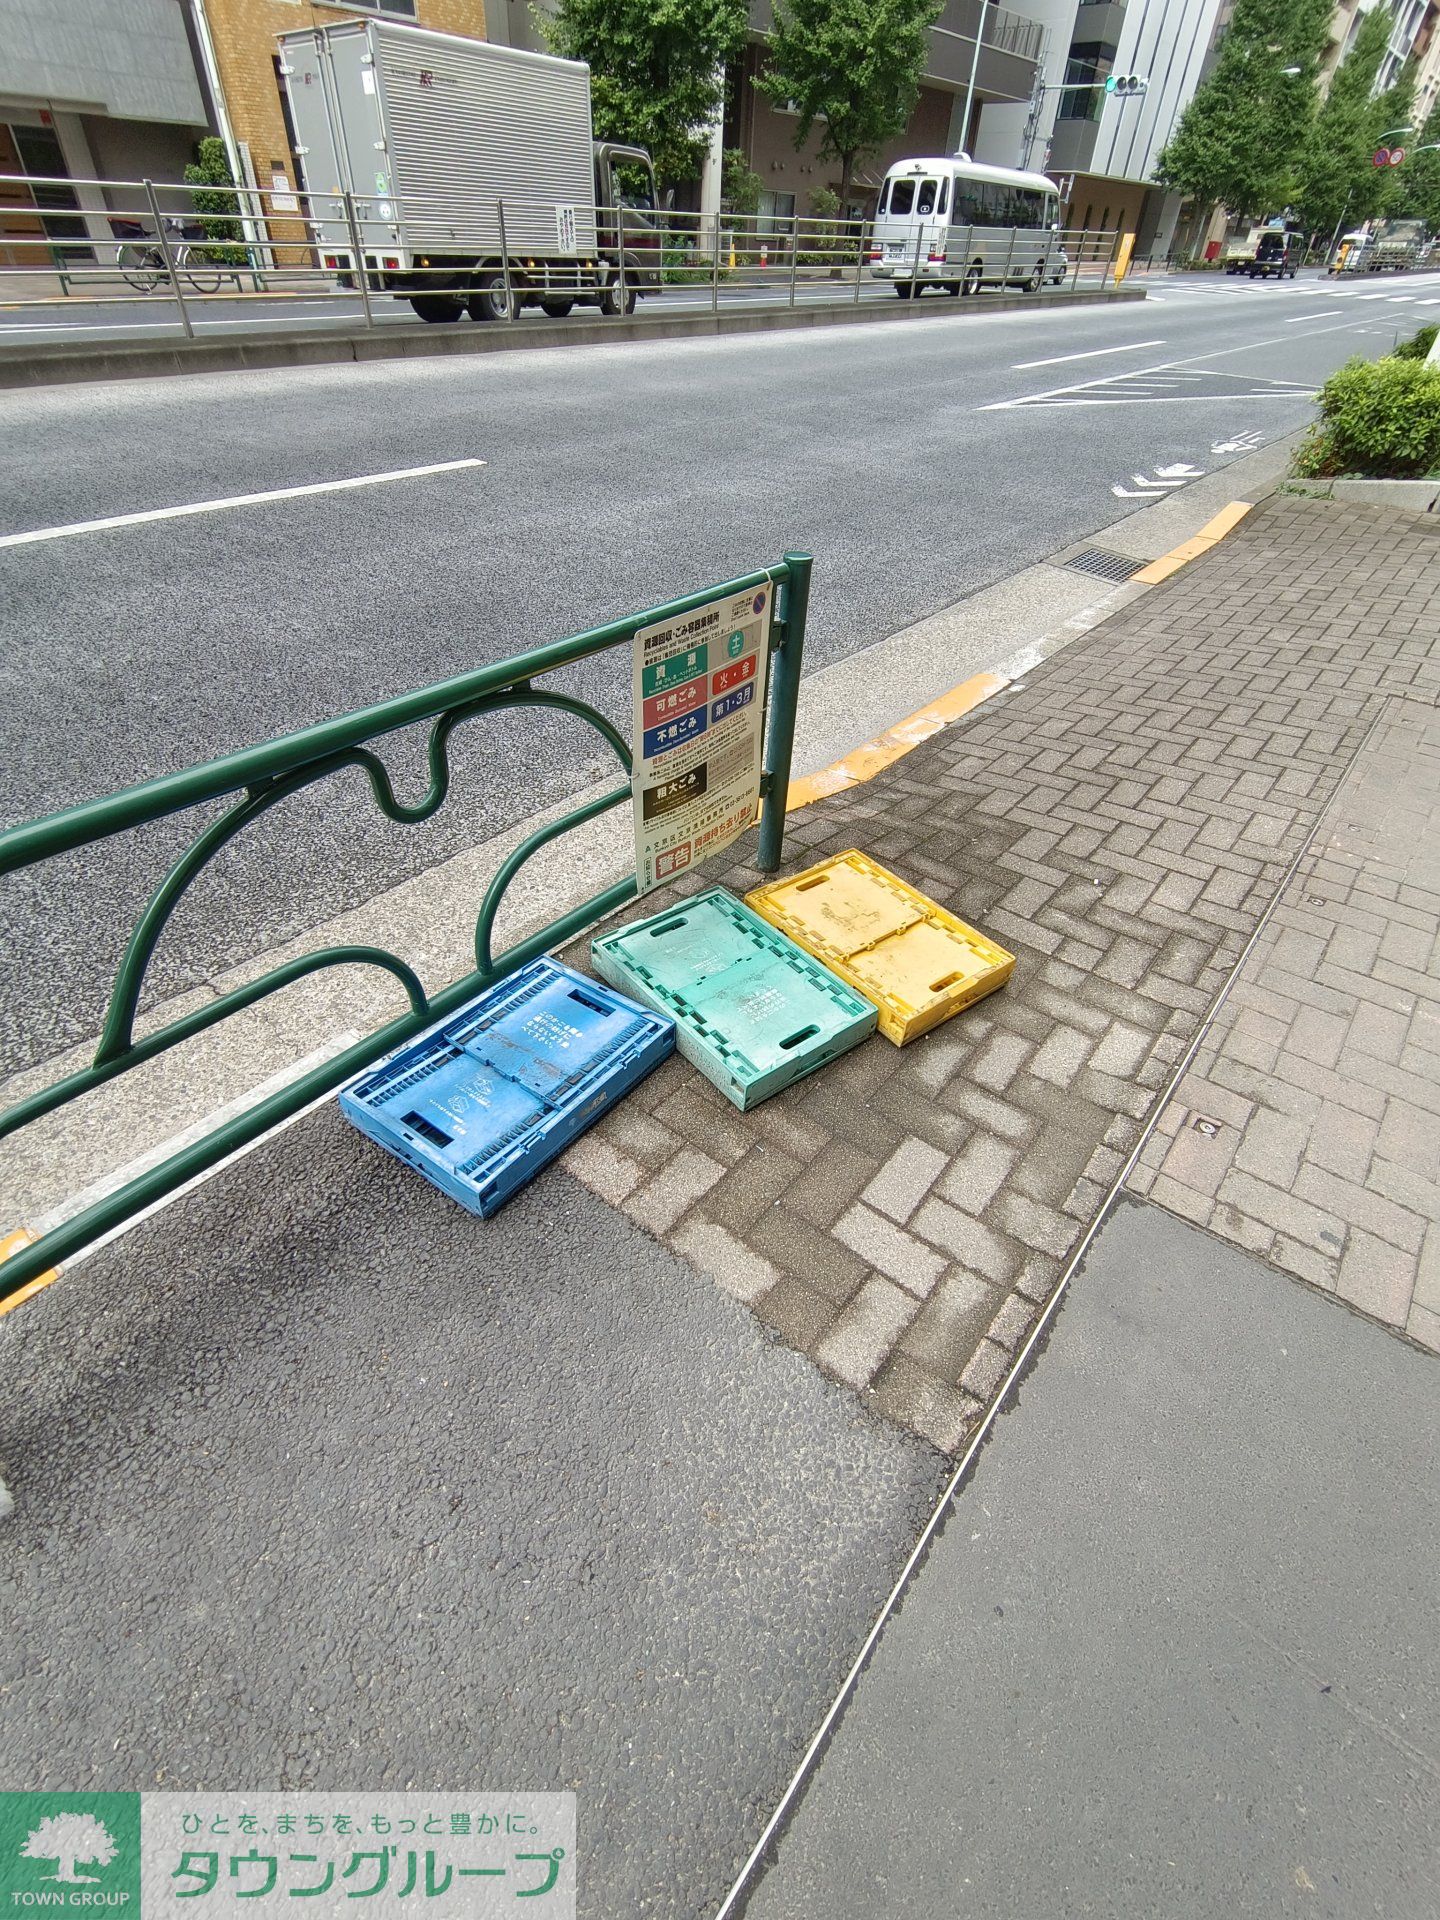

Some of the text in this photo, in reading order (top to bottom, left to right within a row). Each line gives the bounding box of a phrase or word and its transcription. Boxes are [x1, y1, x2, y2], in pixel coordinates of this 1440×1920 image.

[731, 633, 741, 650] 土
[719, 661, 750, 687] 火・金
[656, 686, 697, 712] 可燃ごみ
[656, 717, 697, 743] 不燃ごみ
[656, 772, 697, 800] 粗大ごみ
